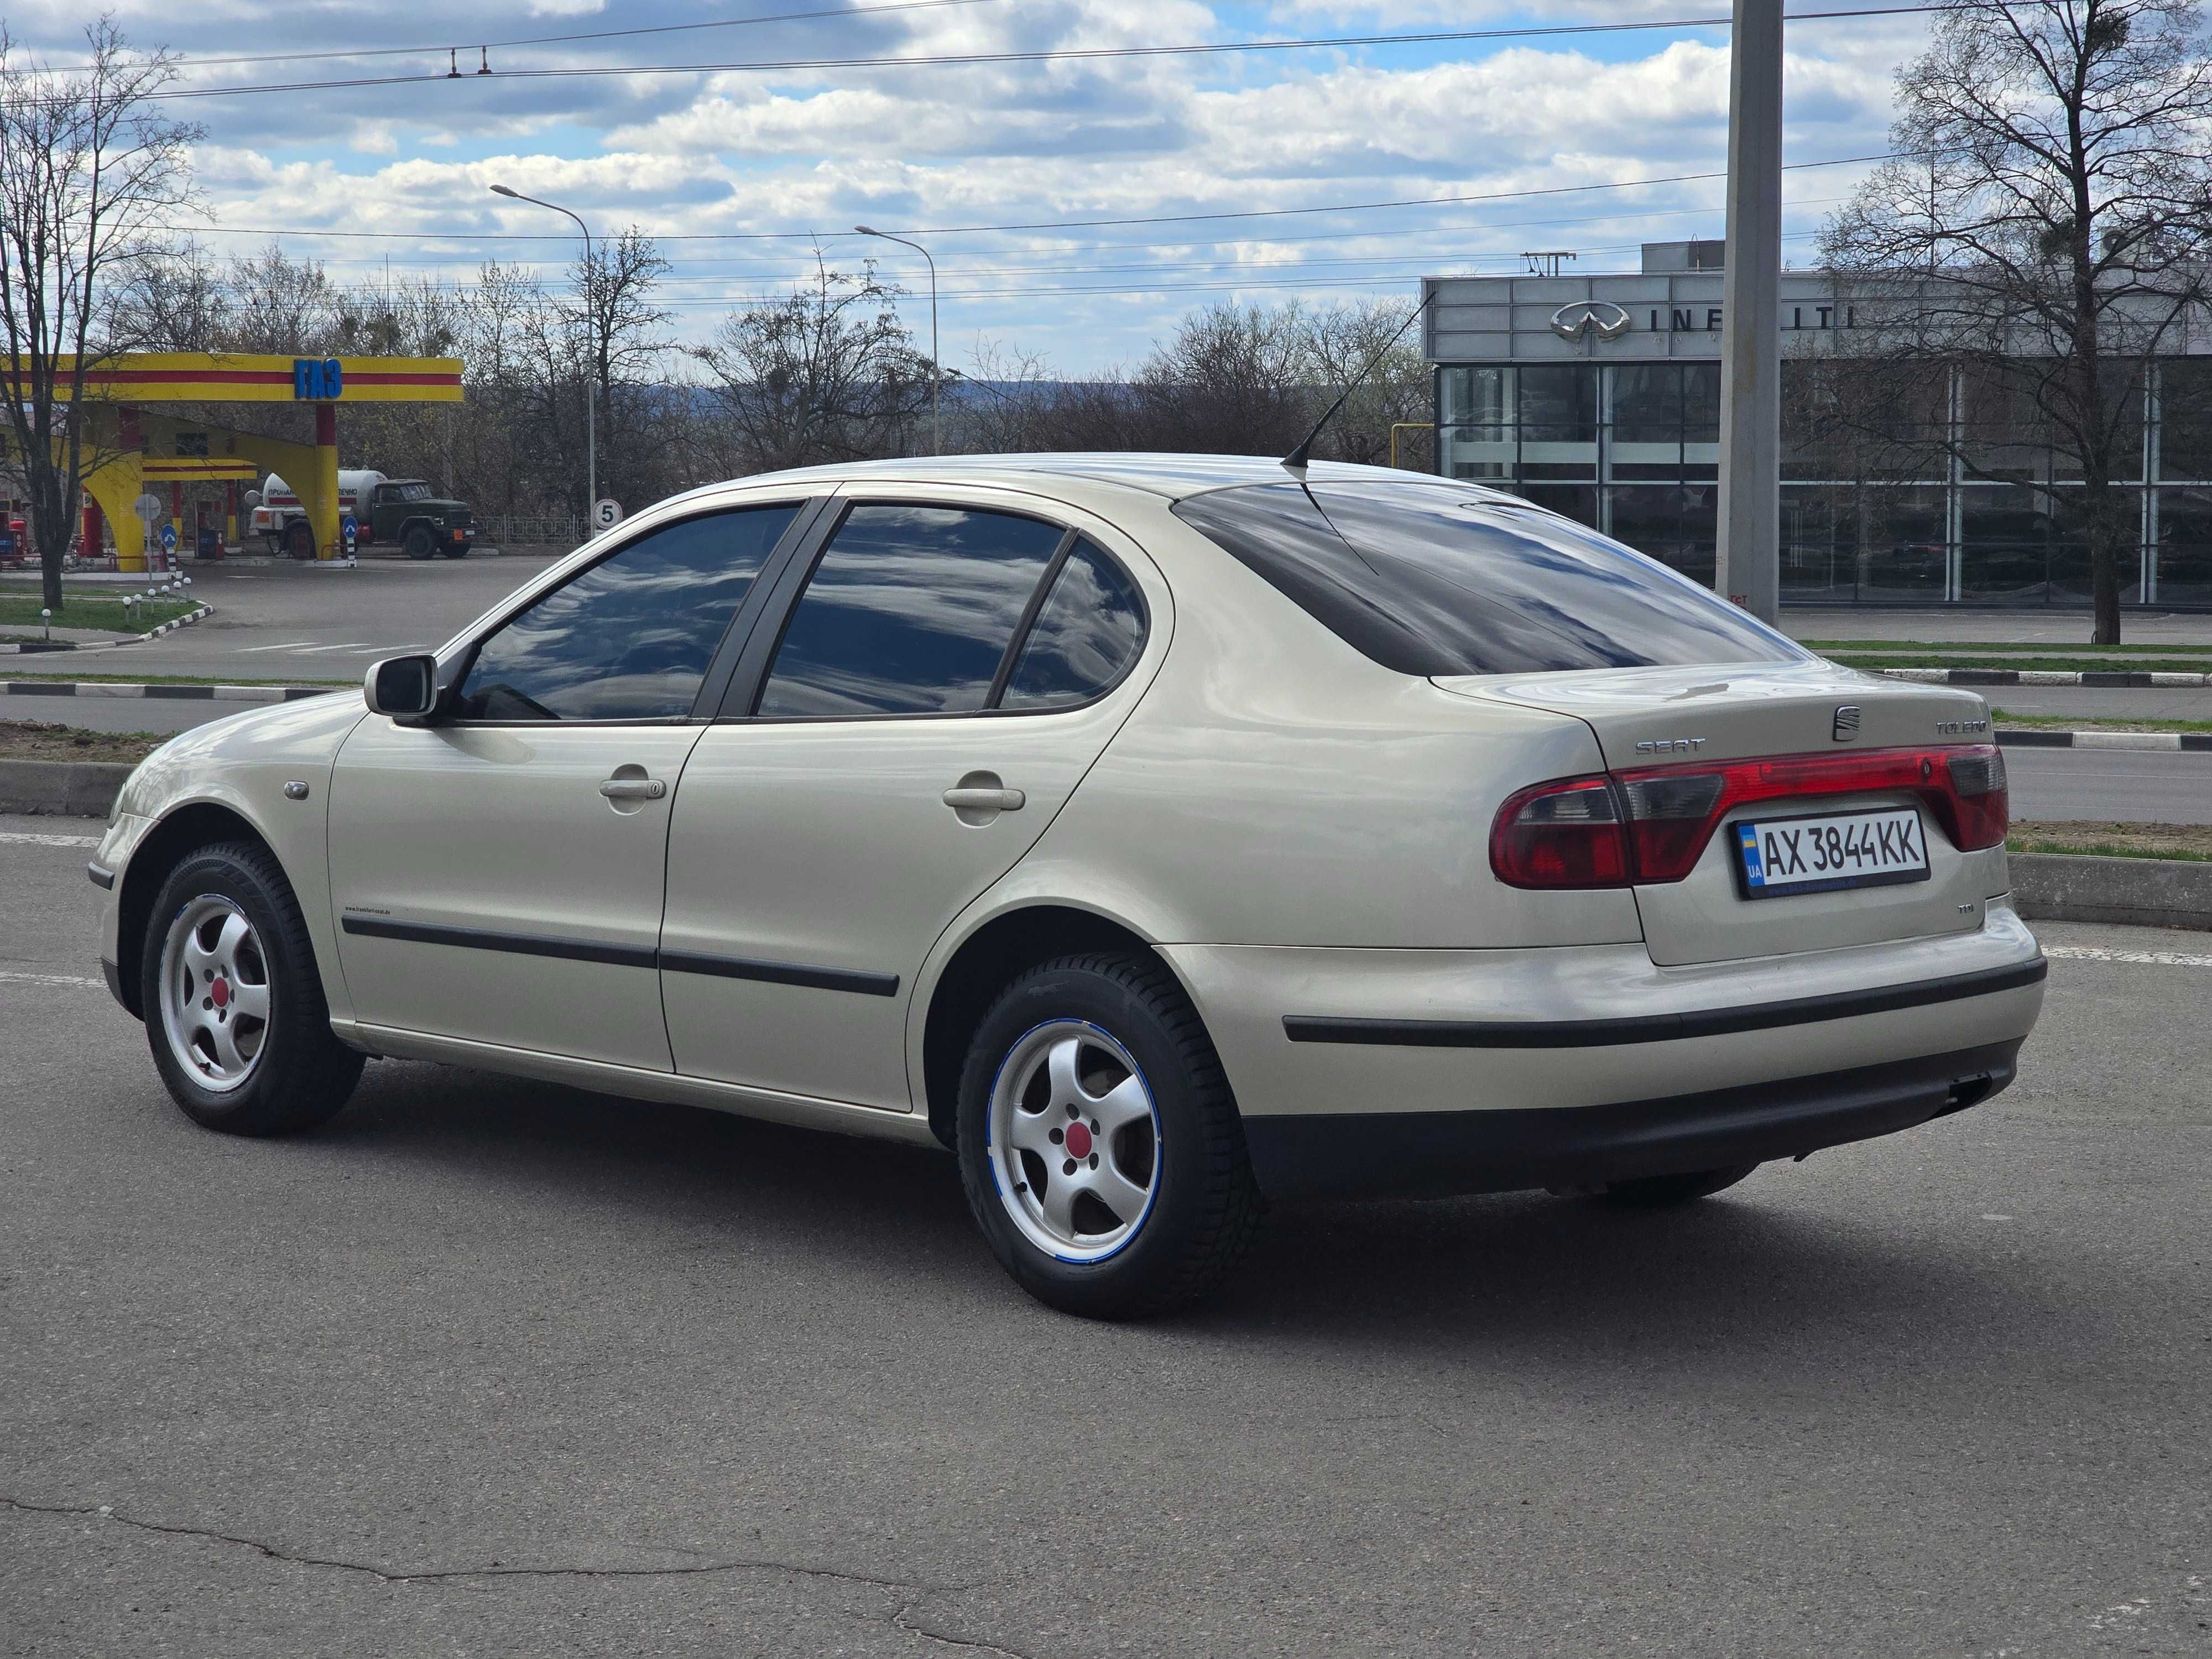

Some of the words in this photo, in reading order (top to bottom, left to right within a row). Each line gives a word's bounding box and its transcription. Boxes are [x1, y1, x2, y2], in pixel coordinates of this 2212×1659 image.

[1651, 306, 1853, 332] INFITI
[294, 358, 342, 399] ГАЗ
[602, 505, 613, 523] 5
[1937, 721, 1986, 734] TOLEDO
[1636, 738, 1705, 755] SEAT
[1748, 865, 1762, 879] UA
[1958, 904, 1974, 914] TDI
